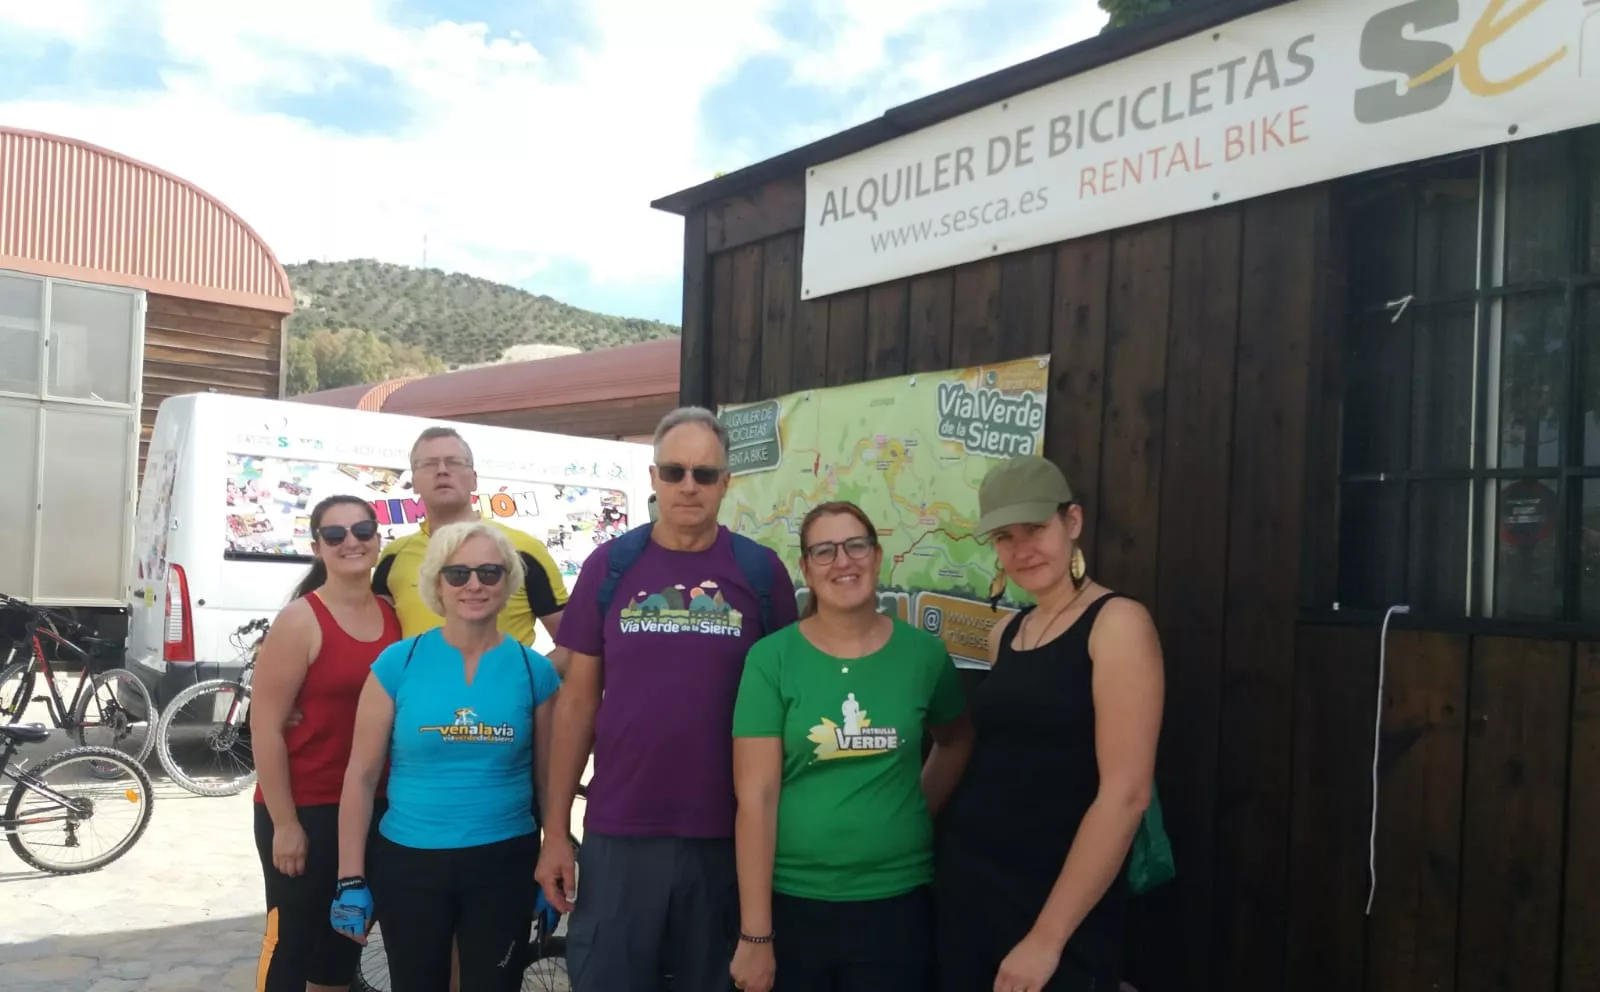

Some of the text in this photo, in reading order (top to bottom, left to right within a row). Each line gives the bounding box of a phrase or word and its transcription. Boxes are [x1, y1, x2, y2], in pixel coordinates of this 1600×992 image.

[819, 34, 1315, 226] ALQUILER DE BICICLETAS
[1079, 105, 1309, 199] RENTAL BIKE
[871, 186, 1049, 253] www.sesca.es
[940, 387, 1042, 428] Vía Verde
[728, 423, 768, 442] ICICLETAS
[941, 422, 1032, 455] de la Sierra
[641, 620, 680, 633] Verde
[692, 624, 700, 632] la
[700, 621, 742, 637] Sierra
[835, 727, 898, 750] VERDE
